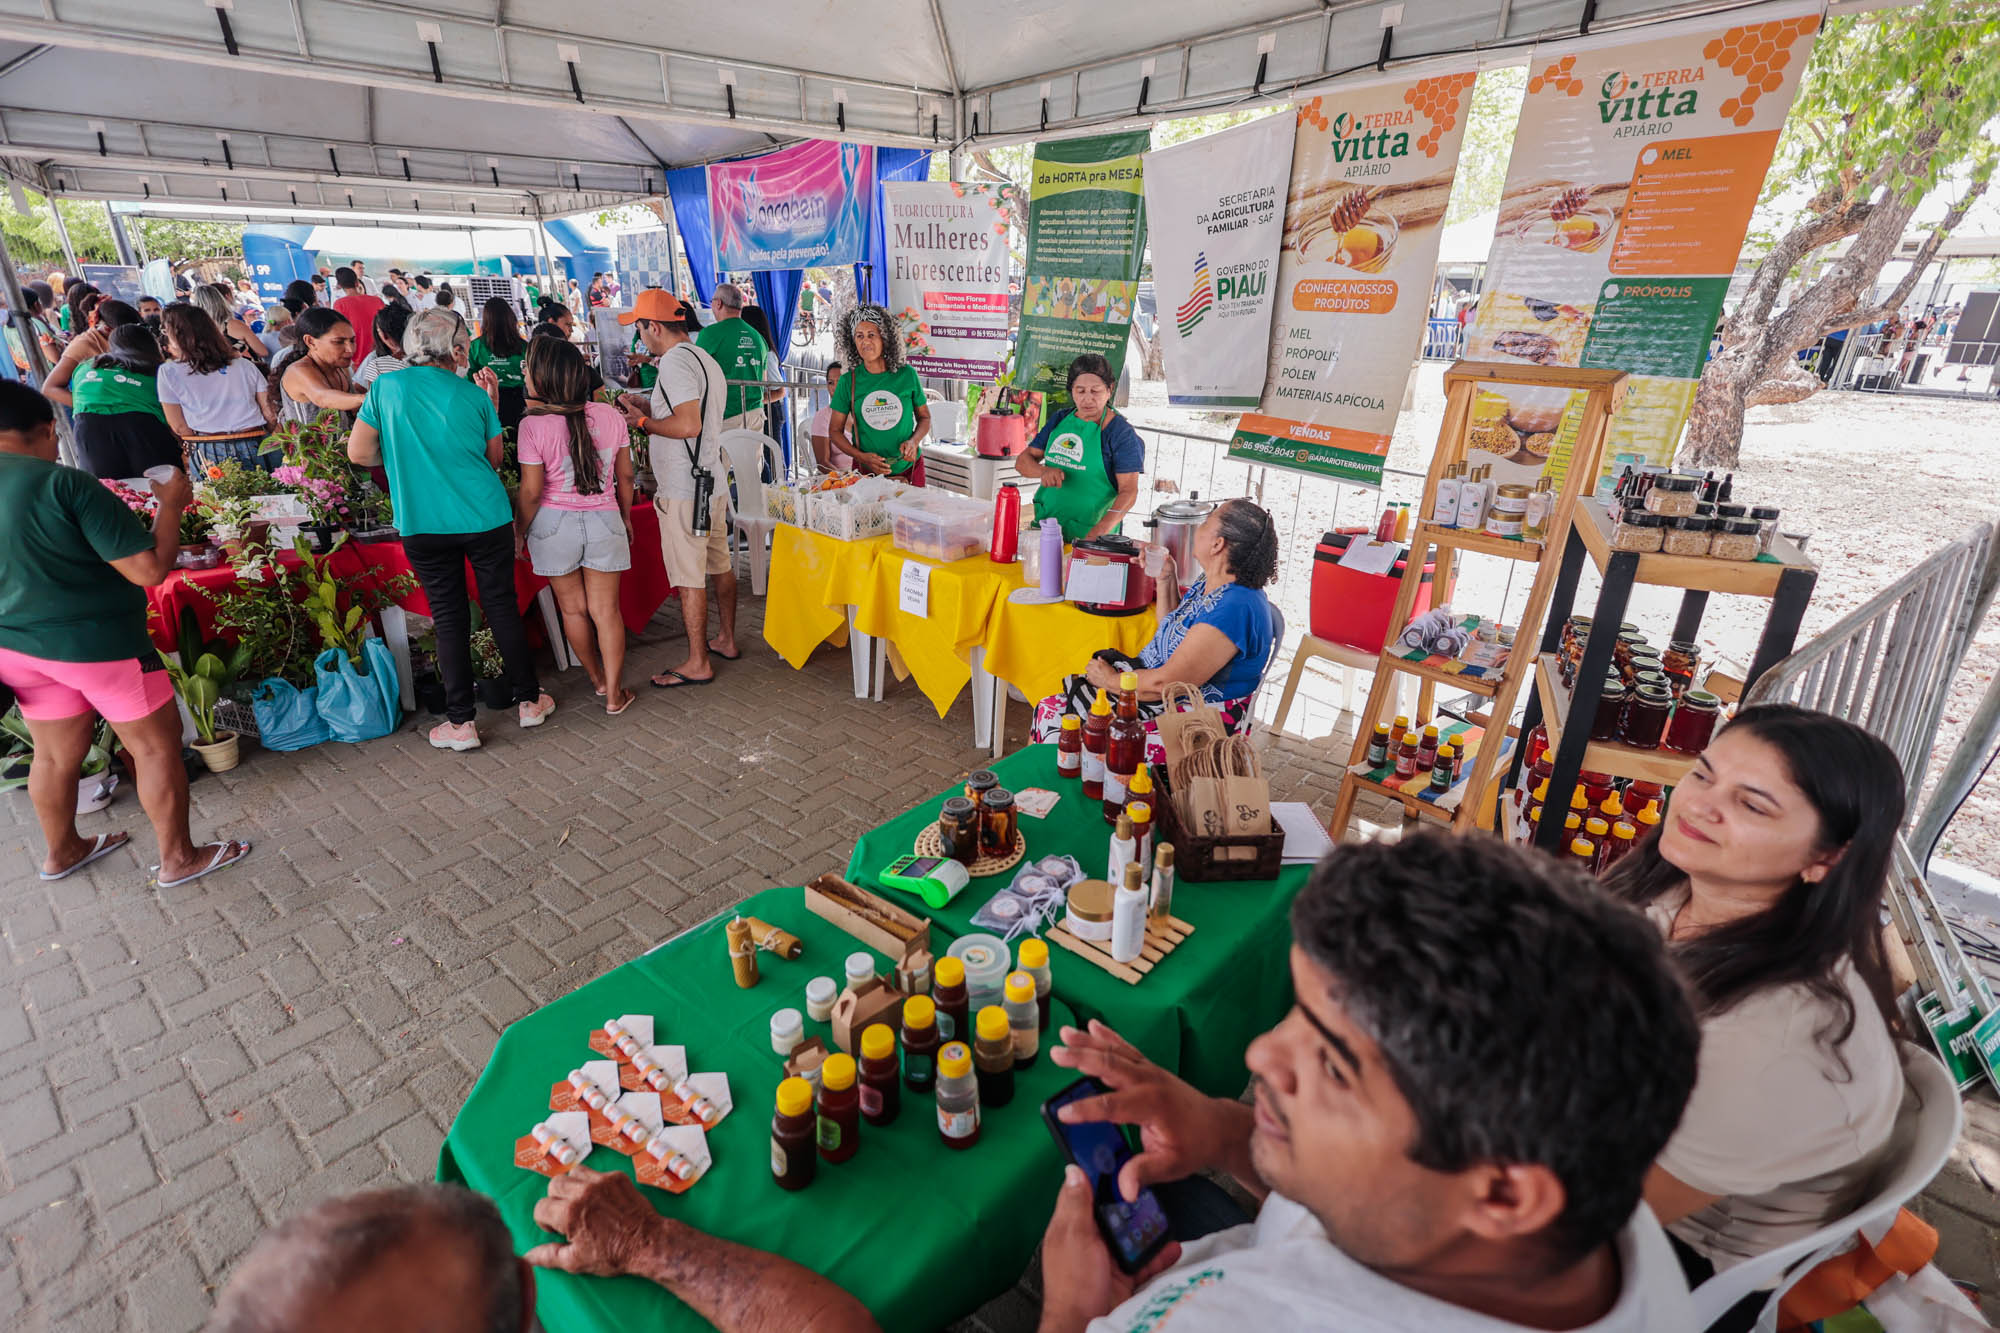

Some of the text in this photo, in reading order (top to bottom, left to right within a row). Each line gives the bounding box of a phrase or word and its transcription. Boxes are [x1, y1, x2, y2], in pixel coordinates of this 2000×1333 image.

[1643, 67, 1705, 89] TERRA
[1364, 109, 1414, 129] TERRA
[1613, 121, 1673, 138] APIÁRIO
[1662, 148, 1693, 161] MEL
[1038, 173, 1050, 184] da
[1053, 171, 1087, 183] HORTA
[1089, 172, 1106, 184] pra
[1344, 163, 1391, 178] APIÁRIO
[1219, 186, 1276, 207] SECRETARIA
[893, 204, 974, 218] FLORICULTURA
[1197, 200, 1275, 225] DA AGRICULTURA
[1207, 218, 1248, 235] FAMILIAR
[1258, 213, 1274, 225] SAF
[894, 223, 989, 250] Mulheres
[771, 249, 787, 264] pela
[788, 243, 830, 262] prevenção!
[895, 256, 1000, 282] Florescentes
[1217, 259, 1269, 276] GOVERNO DO
[1217, 270, 1267, 301] PIAUÍ
[1299, 283, 1393, 296] CONHEÇA NOSSOS
[1623, 284, 1693, 298] PRÓPOLIS
[966, 295, 986, 303] Flores
[1314, 298, 1370, 310] PRODUTOS
[1289, 328, 1312, 340] MEL
[1285, 346, 1339, 362] PRÓPOLIS
[1281, 366, 1316, 381] PÓLEN
[1276, 386, 1385, 411] MATERIAIS APÍCOLA
[1289, 424, 1332, 441] VENDAS
[1242, 441, 1253, 451] 86
[1308, 453, 1381, 474] @APIARIOTERRAVITTA
